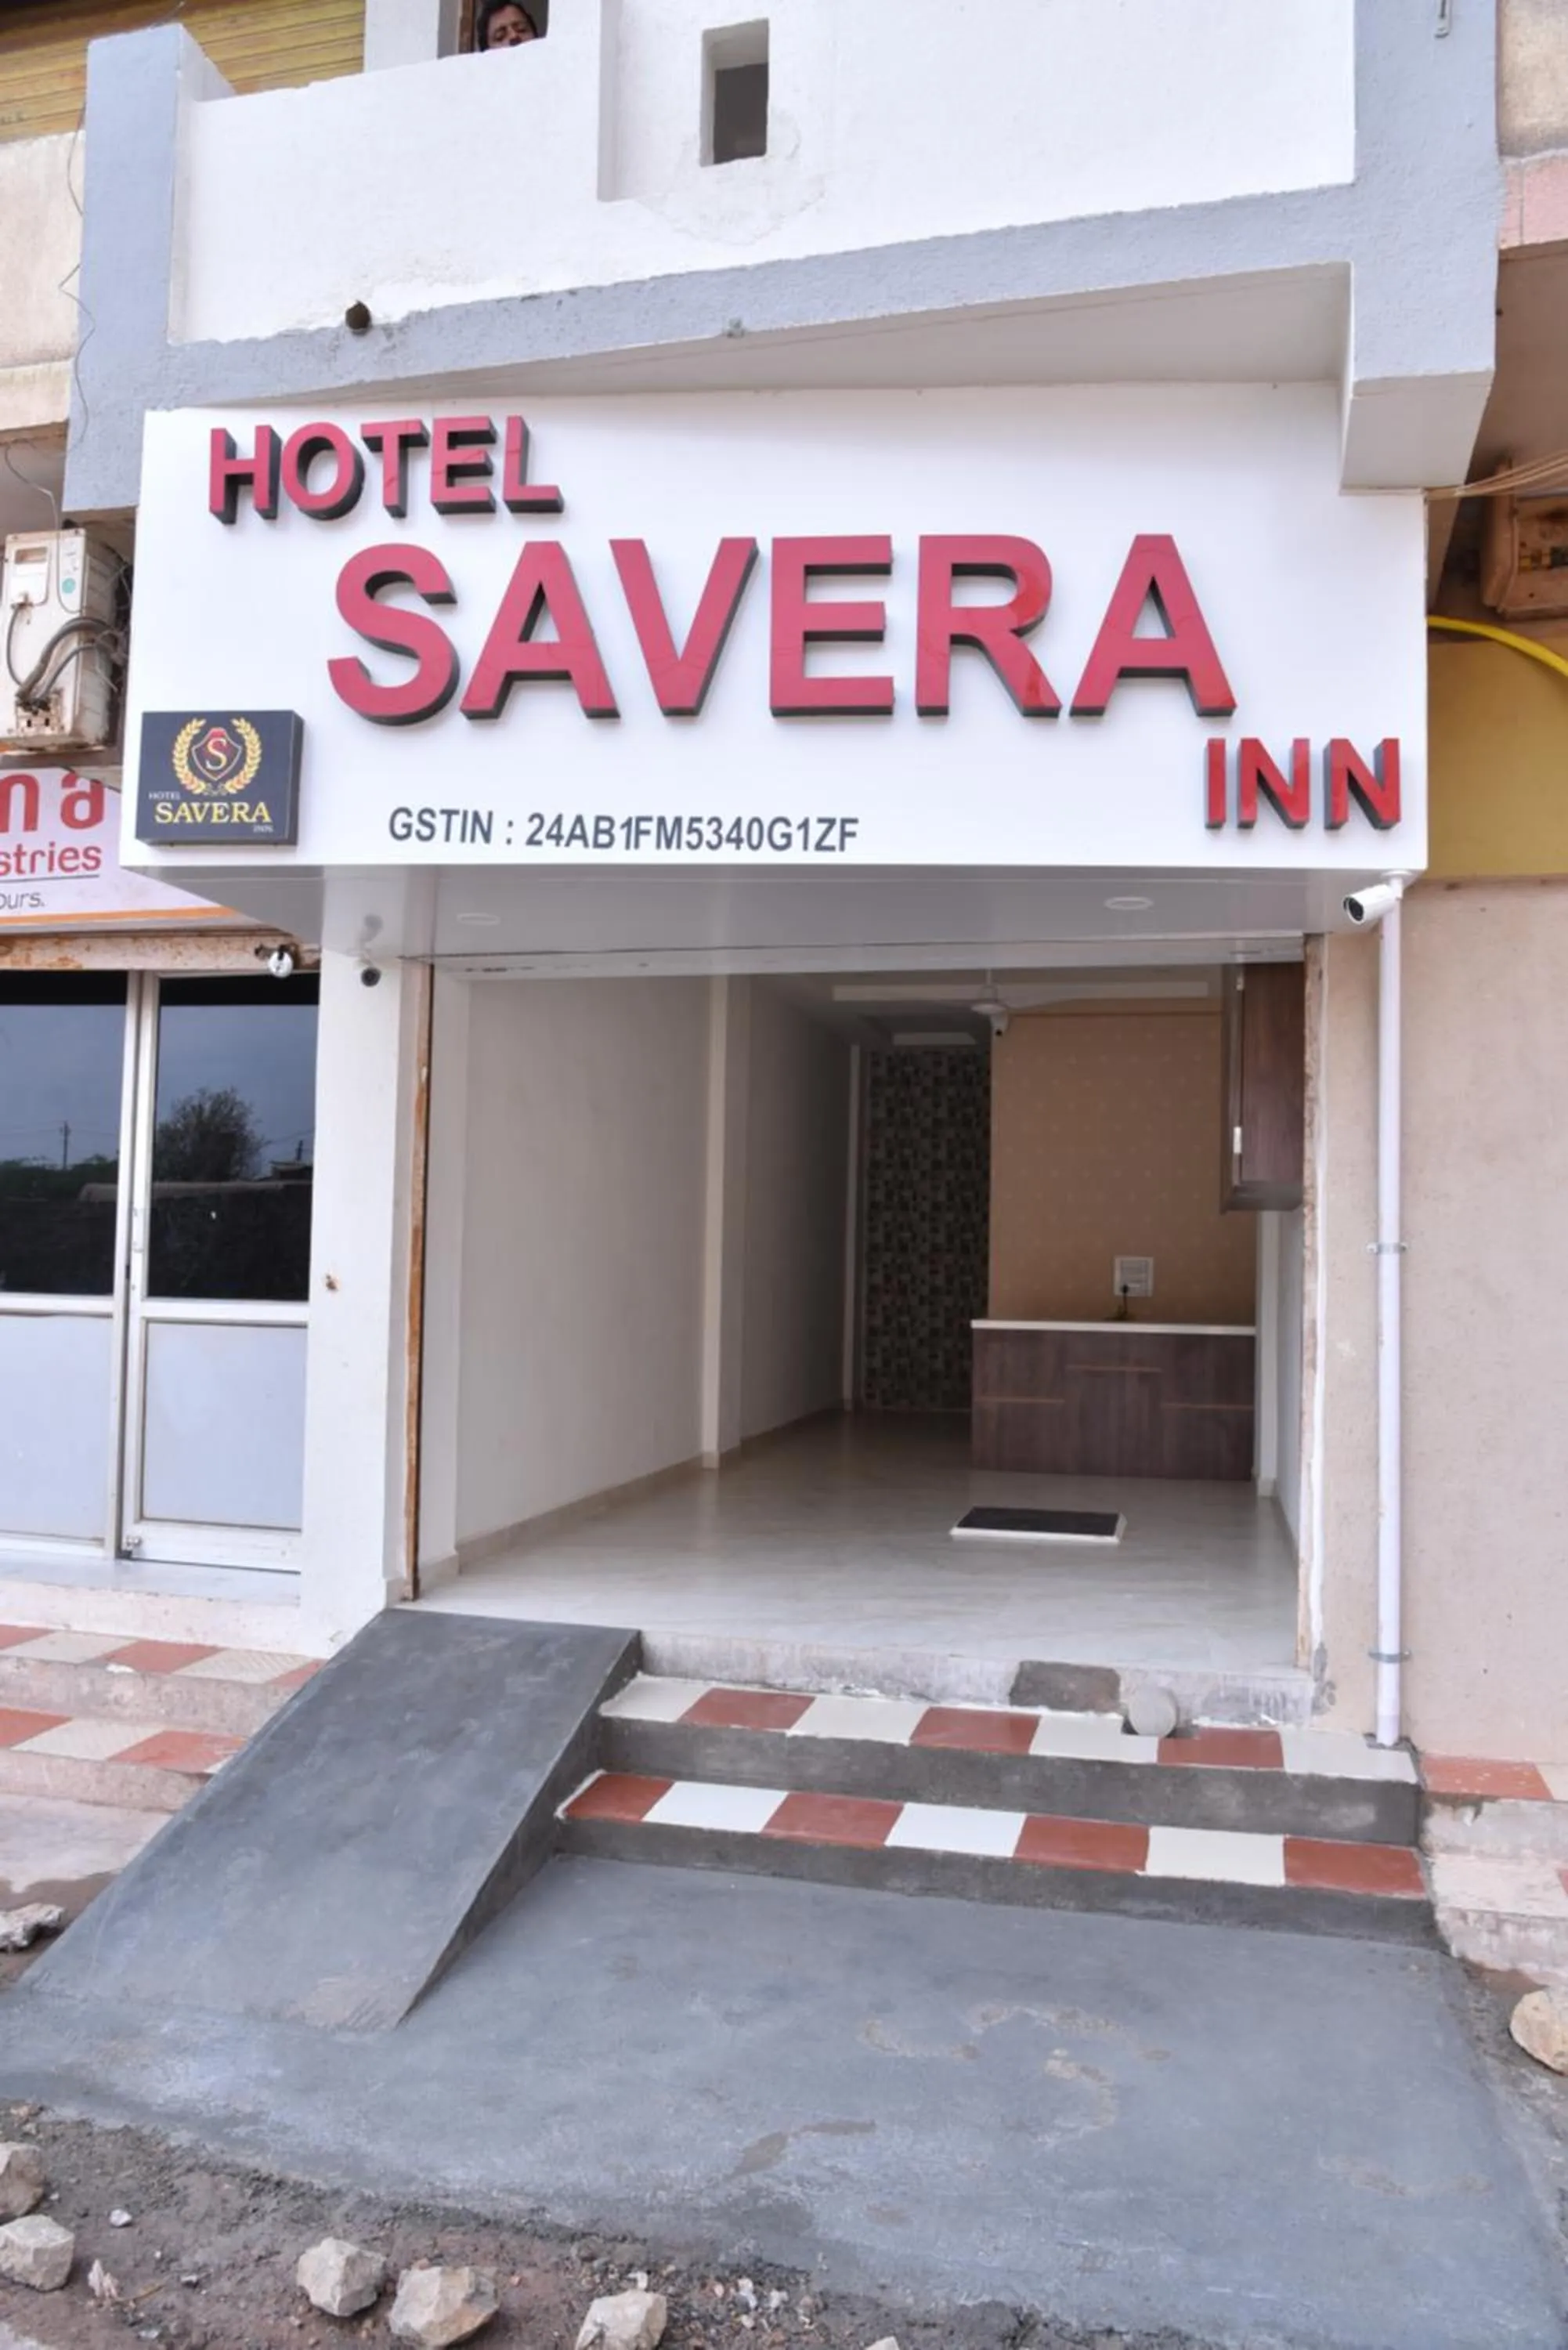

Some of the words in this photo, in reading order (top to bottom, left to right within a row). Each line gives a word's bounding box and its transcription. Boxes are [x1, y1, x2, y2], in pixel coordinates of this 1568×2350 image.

[209, 415, 564, 525] HOTEL
[327, 535, 1237, 727] SAVERA
[205, 737, 227, 770] S
[148, 790, 181, 801] HOTEL
[1205, 738, 1400, 830] INN
[154, 801, 272, 823] SAVERA
[389, 807, 493, 844] GSTIN
